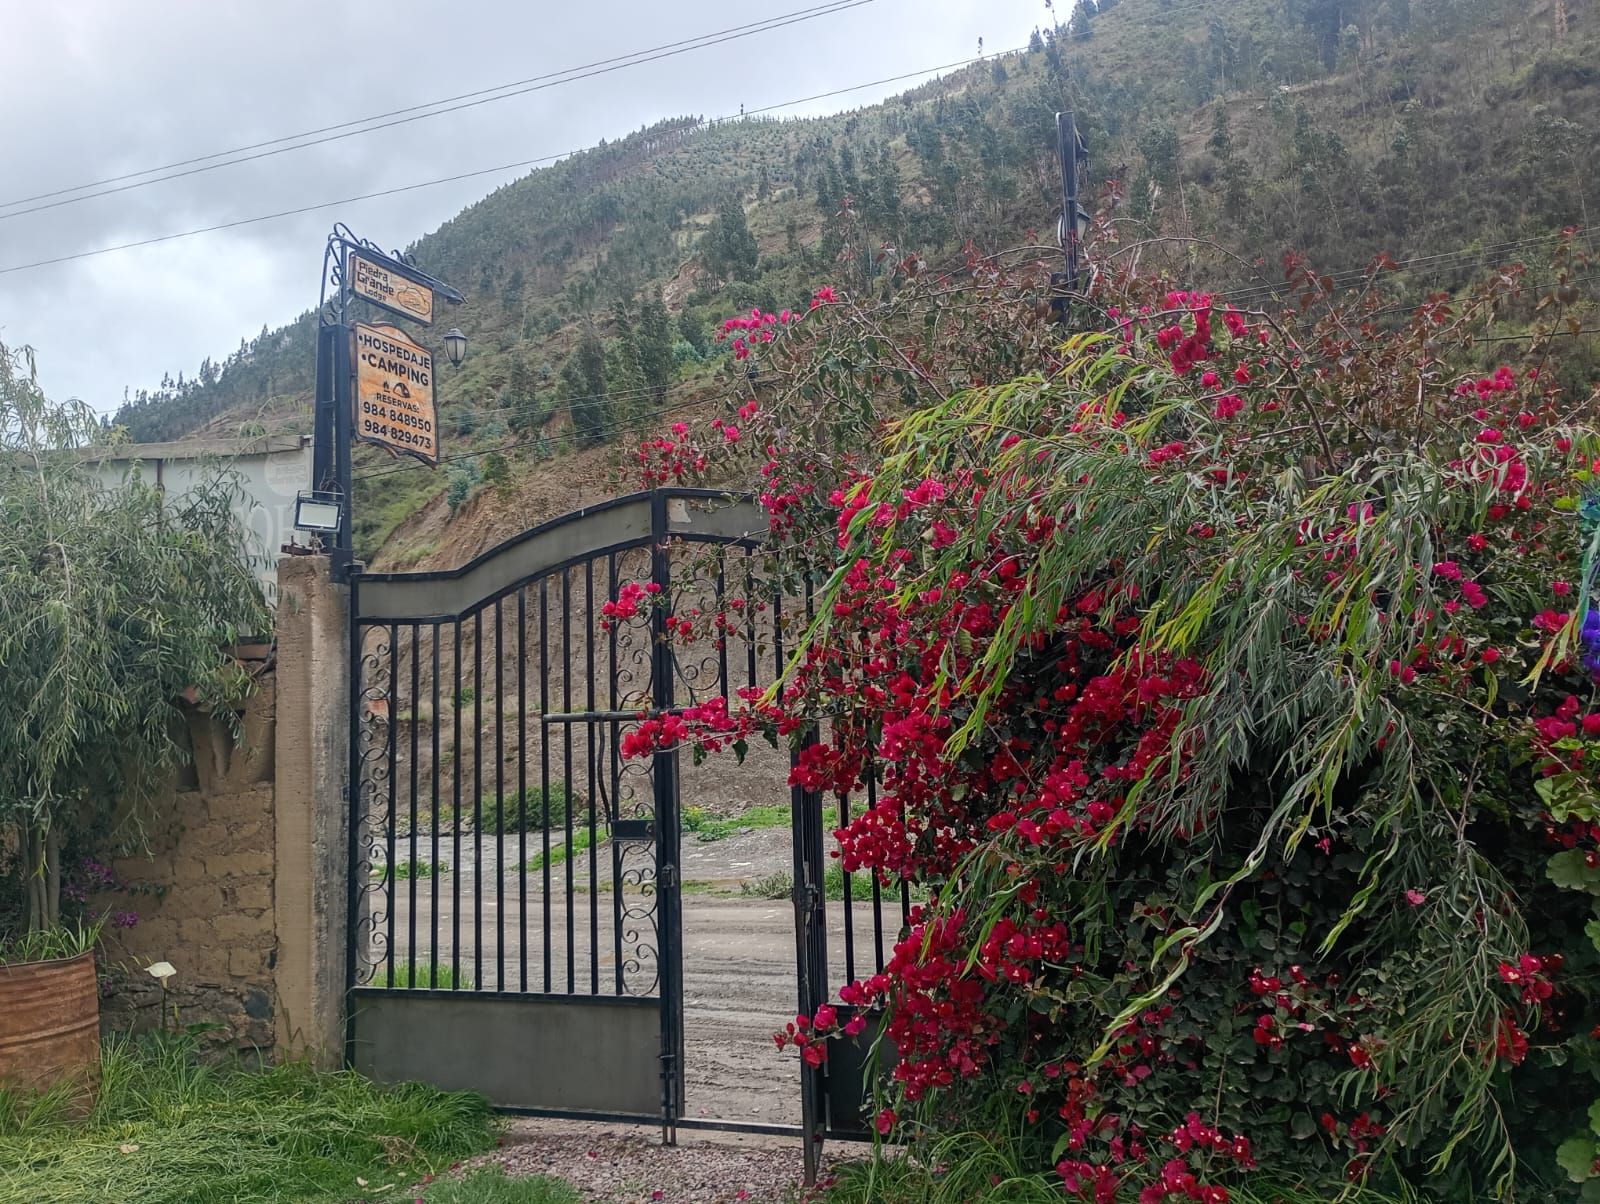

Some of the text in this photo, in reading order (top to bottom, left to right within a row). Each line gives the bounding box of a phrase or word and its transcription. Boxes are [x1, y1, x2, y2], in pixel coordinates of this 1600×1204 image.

[357, 271, 394, 296] Grande
[359, 261, 388, 282] Piedra
[364, 286, 387, 301] Lodge
[363, 333, 430, 370] HOSPEDAJE
[367, 353, 429, 387] CAMPING
